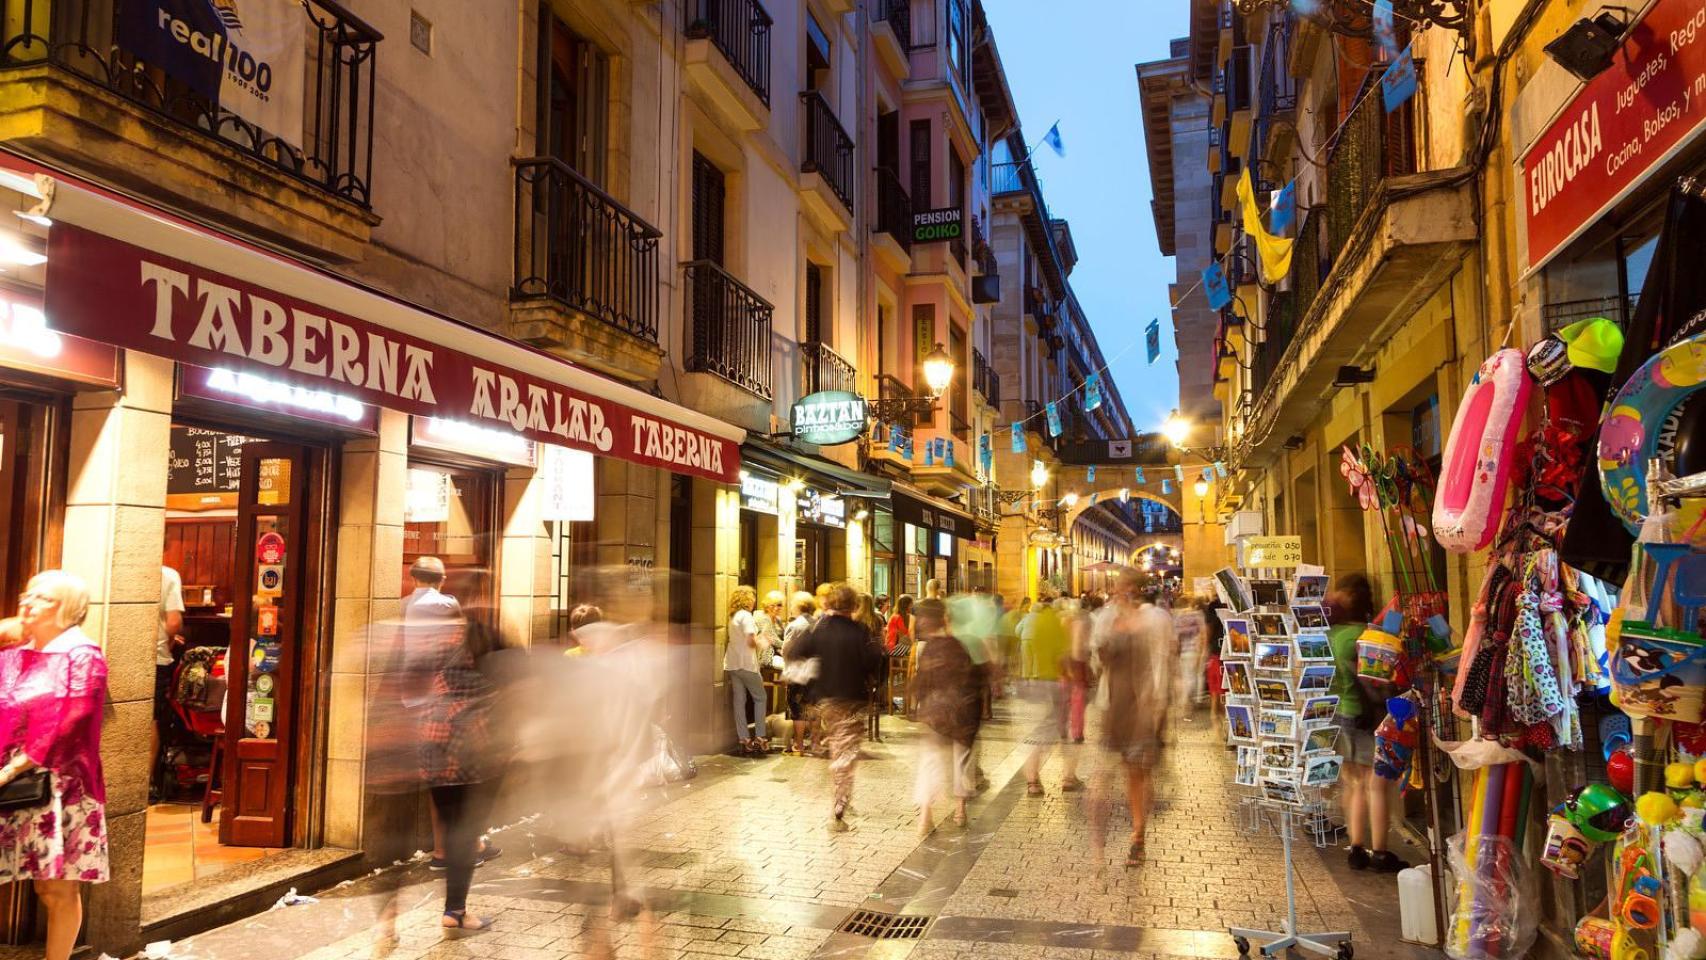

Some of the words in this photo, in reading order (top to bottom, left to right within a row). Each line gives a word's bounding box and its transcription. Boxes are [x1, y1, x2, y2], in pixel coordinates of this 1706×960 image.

[158, 7, 222, 62] real
[228, 42, 272, 92] 100
[1616, 52, 1667, 115] Juguetes,
[1531, 101, 1603, 217] EUROCASA
[1607, 136, 1642, 176] Cocina,
[1644, 100, 1681, 143] Bolsos,
[1683, 86, 1691, 113] y
[914, 209, 960, 226] PENSION
[915, 223, 960, 240] GOIKO
[140, 261, 438, 405] TABERNA
[470, 366, 613, 452] ARALAR
[631, 414, 724, 475] TABERNA
[794, 400, 864, 426] BAZTAN
